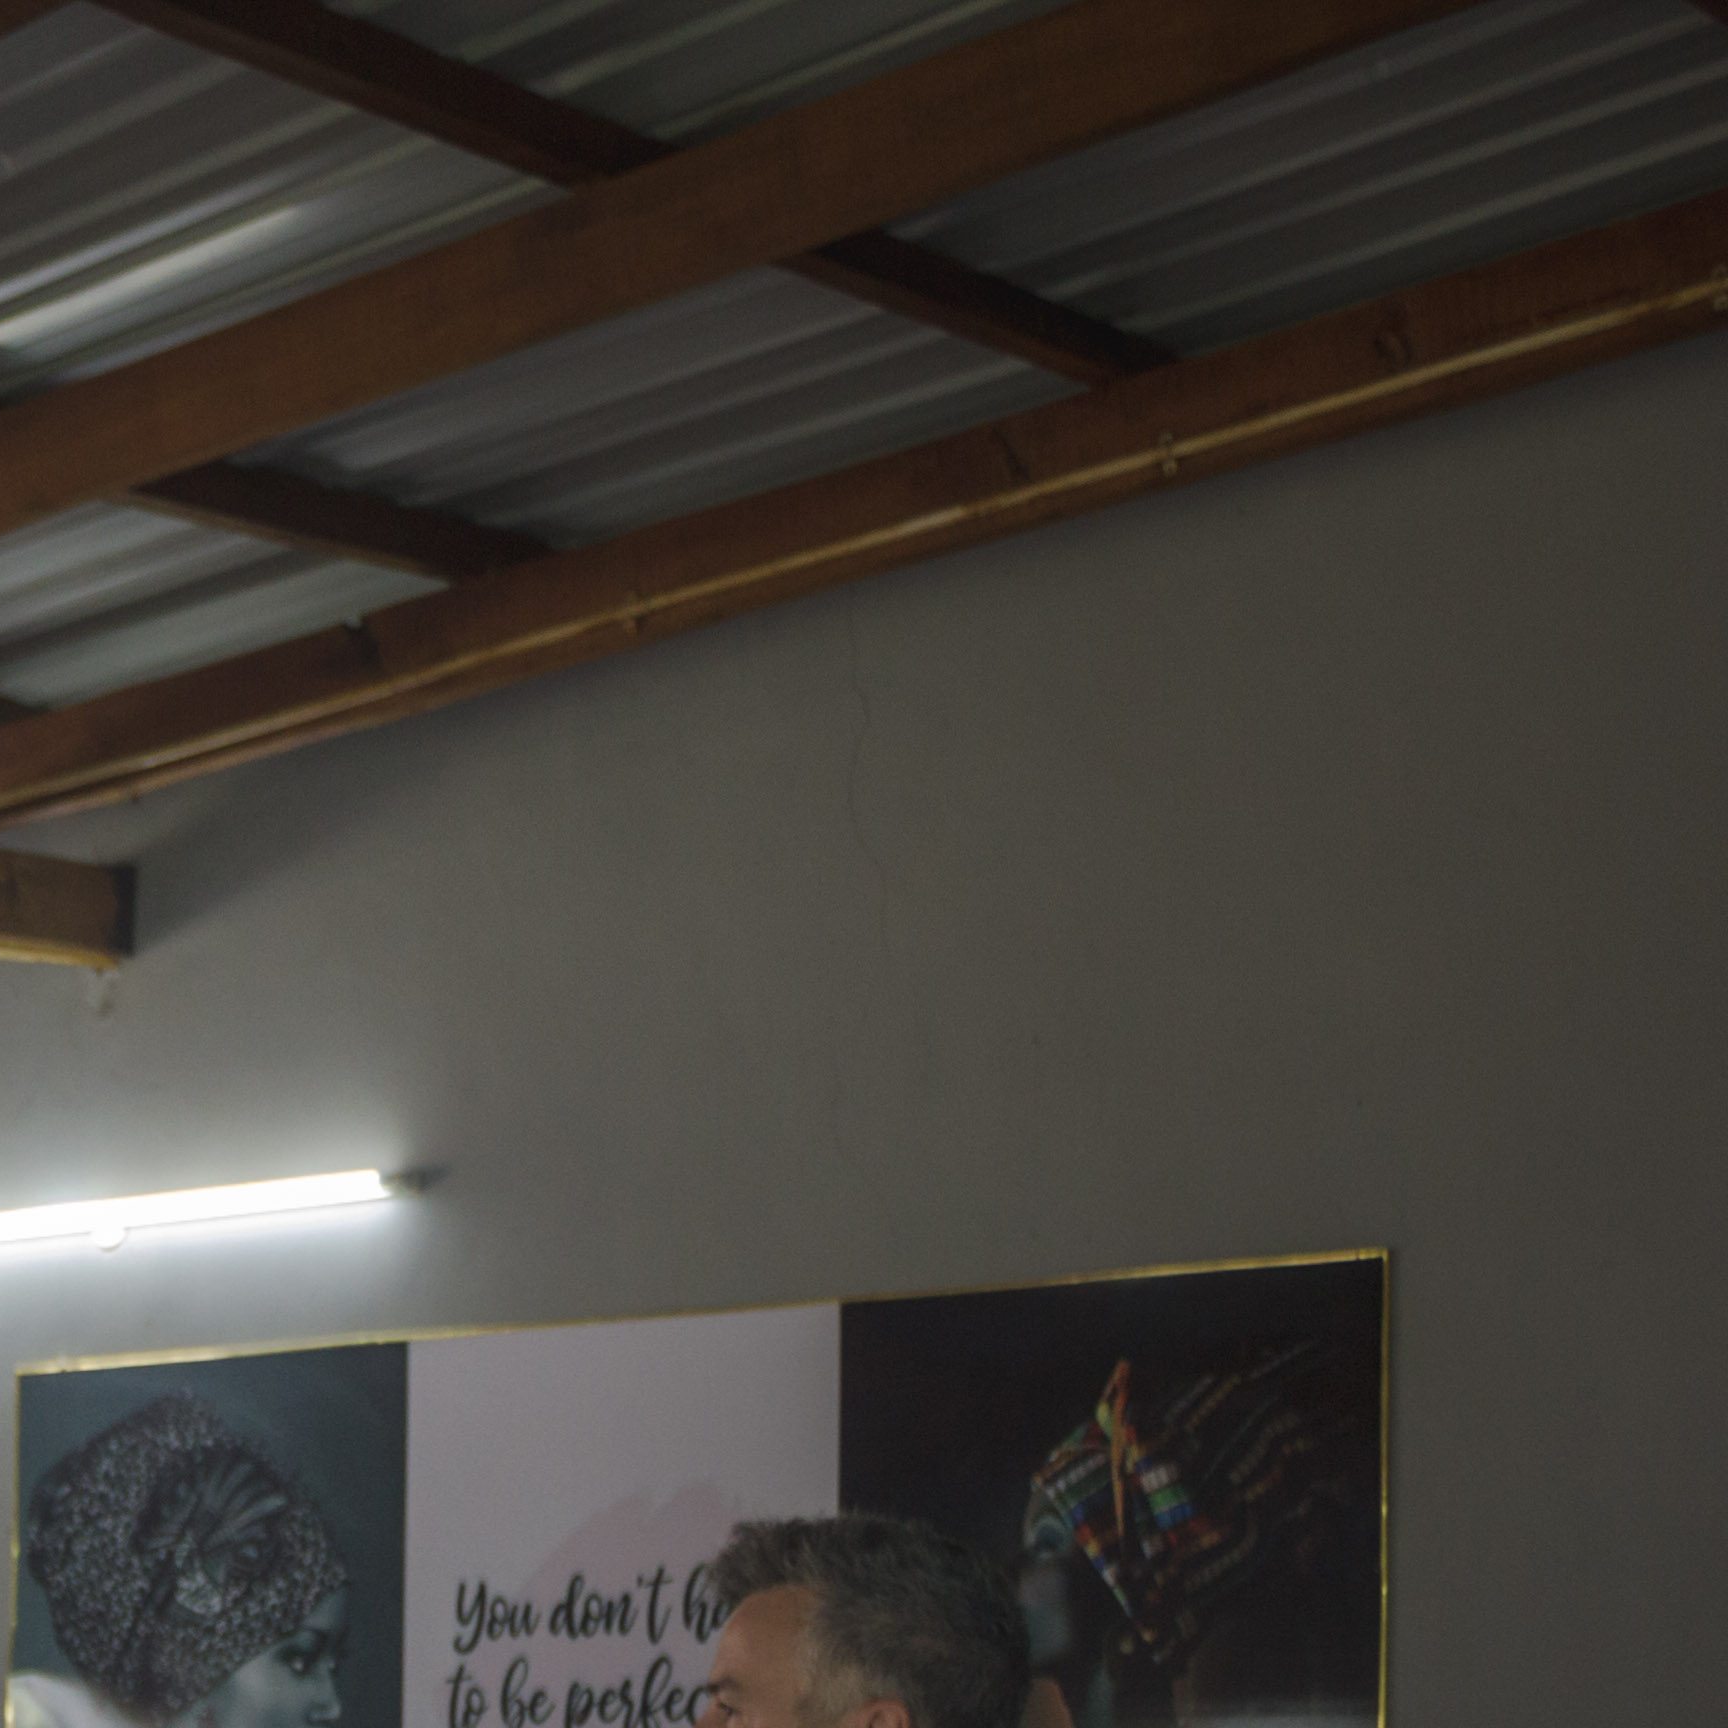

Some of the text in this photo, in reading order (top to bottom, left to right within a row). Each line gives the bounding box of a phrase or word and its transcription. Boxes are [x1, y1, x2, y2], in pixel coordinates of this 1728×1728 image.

[453, 1562, 734, 1655] You don't ha
